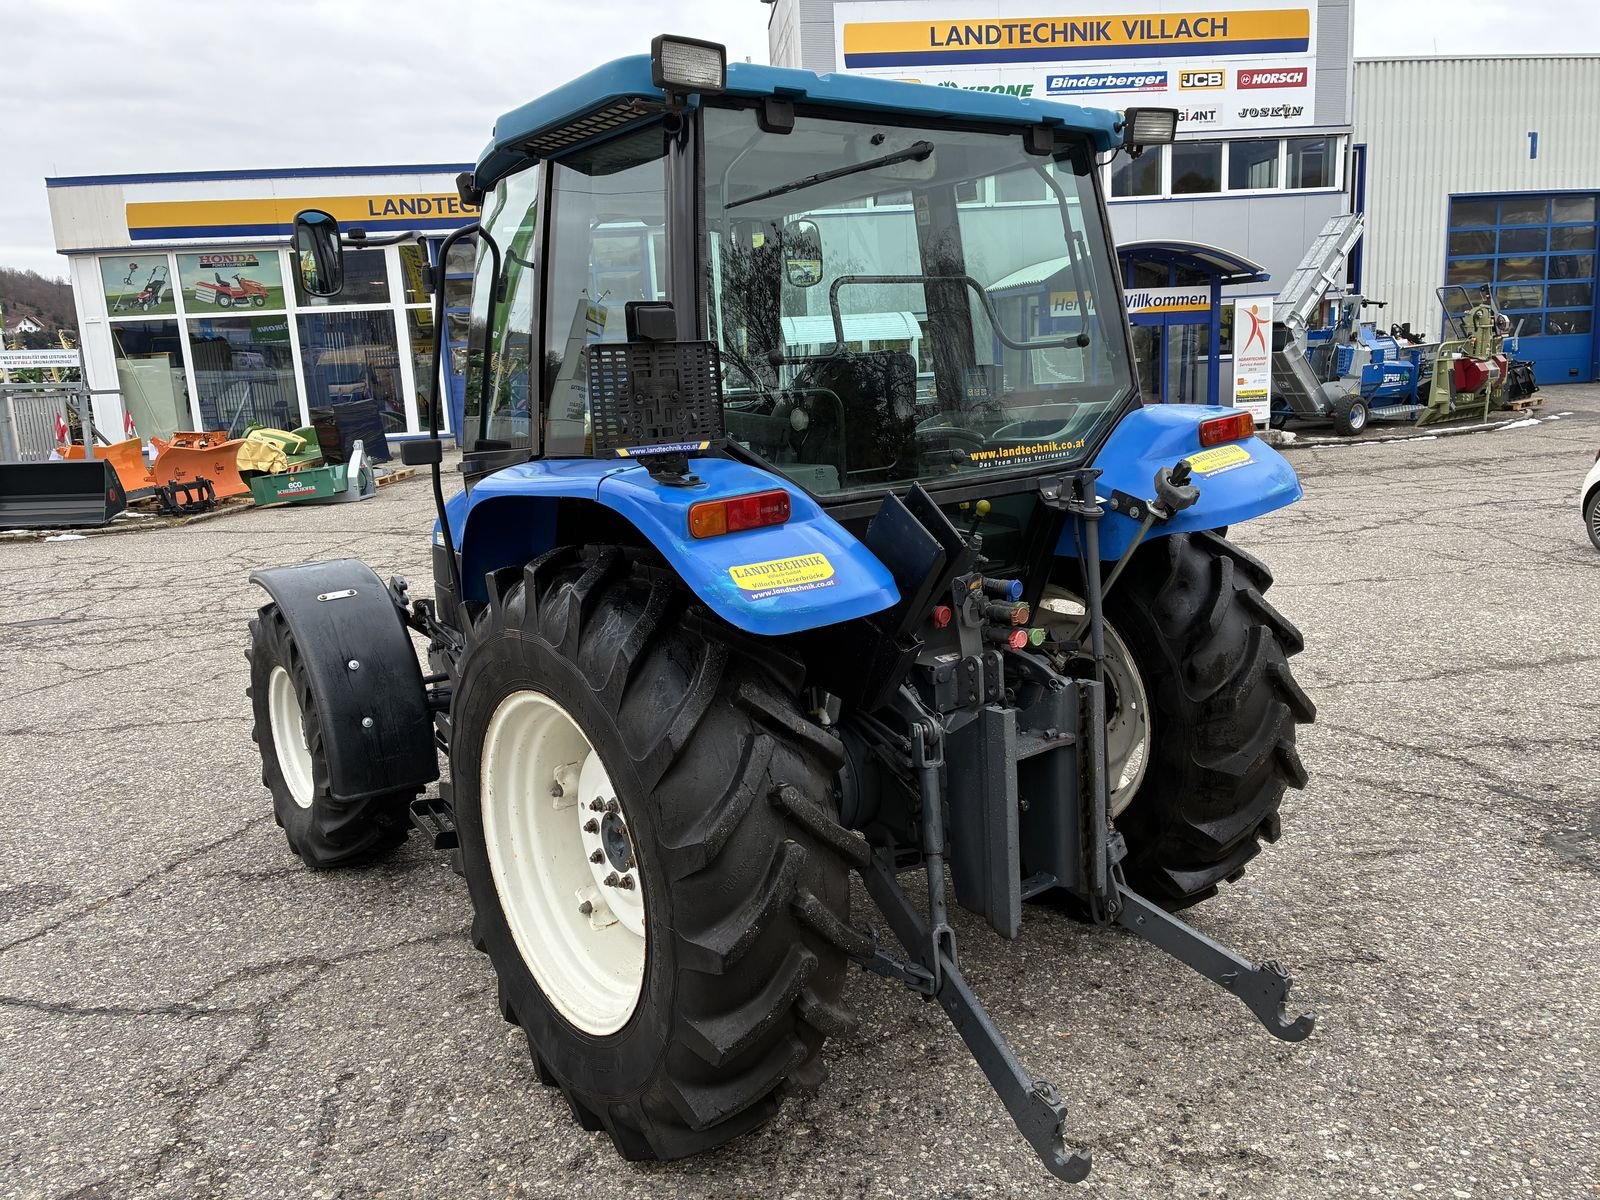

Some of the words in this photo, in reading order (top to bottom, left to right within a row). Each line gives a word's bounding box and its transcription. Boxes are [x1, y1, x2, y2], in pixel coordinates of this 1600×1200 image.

[930, 20, 1112, 47] LANDTECHNIK
[1121, 16, 1228, 40] VILLACH
[1050, 75, 1165, 88] Binderberger
[1182, 73, 1222, 86] JCB
[1251, 72, 1303, 84] HORSCH
[1238, 104, 1304, 119] JOSKIN
[1527, 131, 1538, 160] 1
[368, 197, 480, 216] LANDTEC
[199, 253, 257, 264] HONDA
[629, 444, 698, 455] www.landtechnik.co.at
[970, 438, 1085, 461] www.landtechnik.co.at
[733, 555, 824, 579] LANDTECHNIK
[752, 580, 776, 589] Villach
[782, 572, 824, 585] Lieserbrücke
[751, 579, 835, 600] www.landtechnik.co.at
